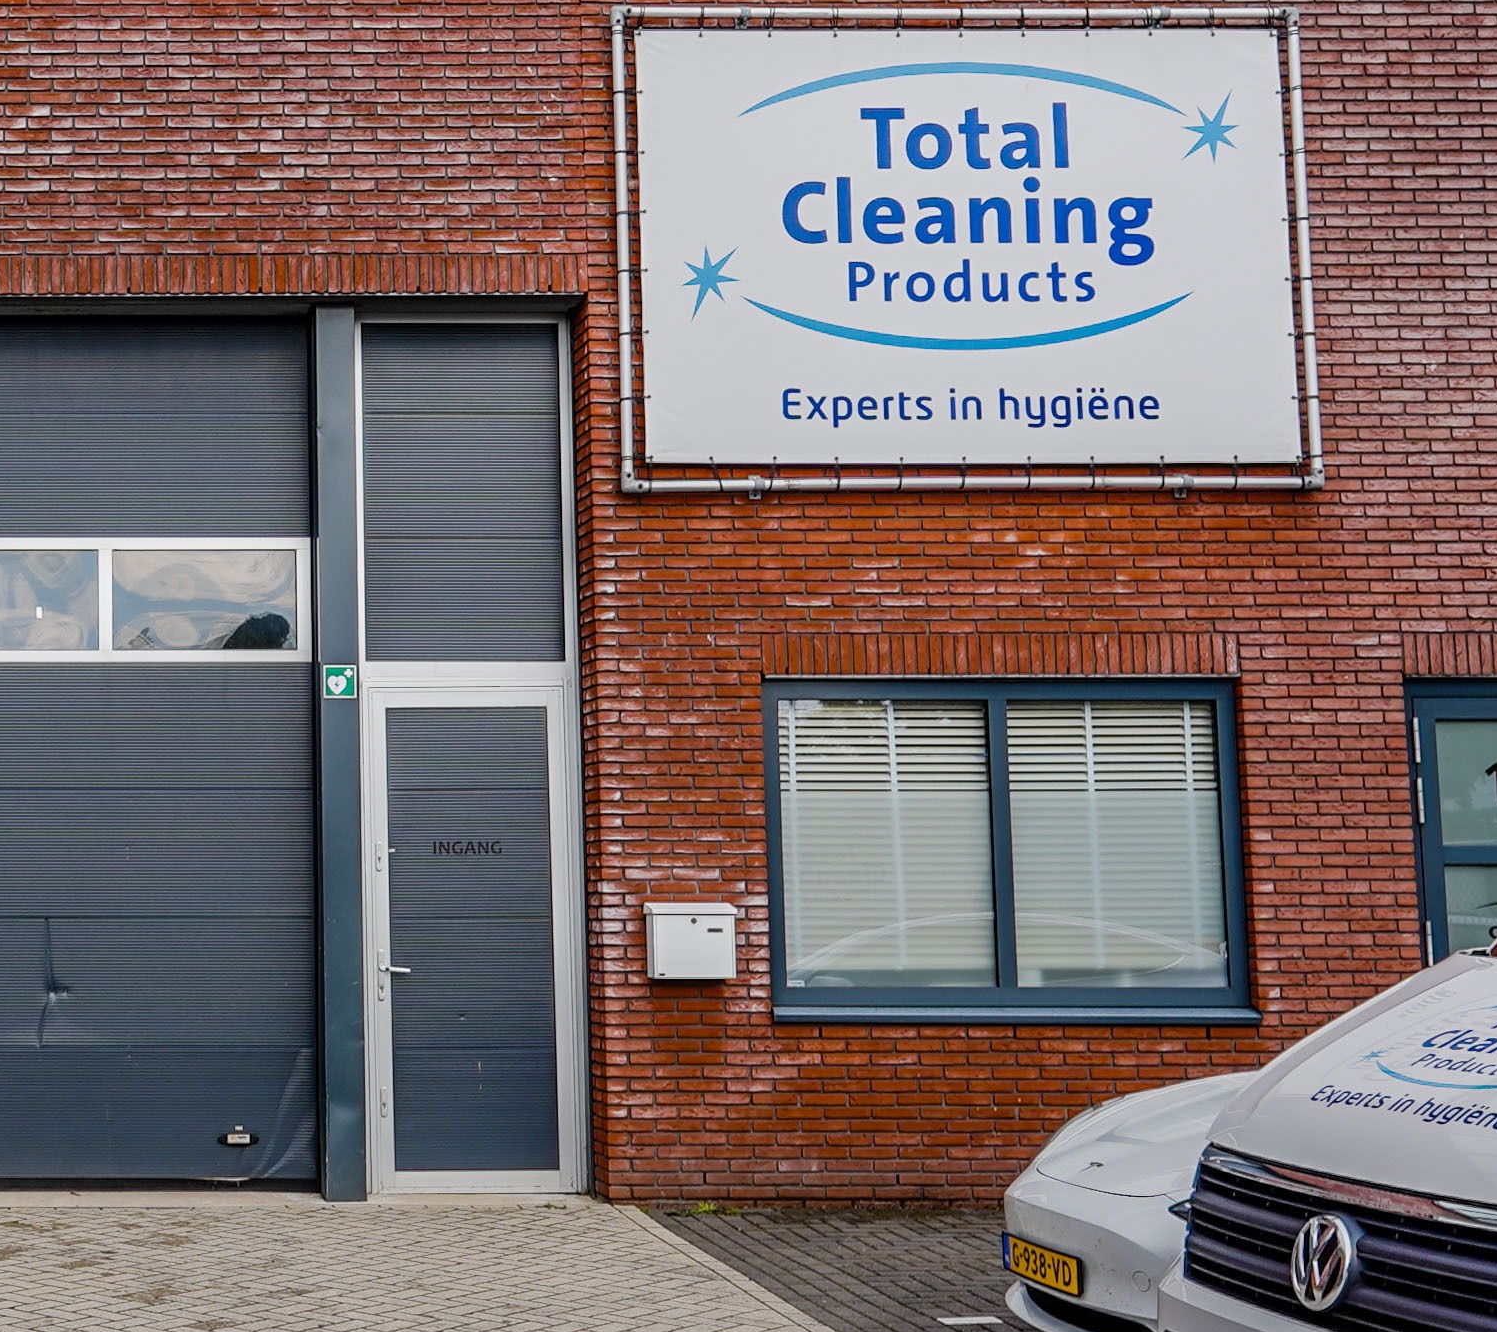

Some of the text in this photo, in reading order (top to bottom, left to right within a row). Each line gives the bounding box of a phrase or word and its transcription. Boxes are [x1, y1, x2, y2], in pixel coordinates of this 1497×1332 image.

[860, 102, 1070, 170] Total
[781, 176, 1156, 267] Cleaning
[847, 259, 1097, 303] Products
[781, 388, 1161, 429] Experts in hygiëne
[432, 840, 503, 856] INGANG
[1310, 1084, 1391, 1109] Experts
[1391, 1093, 1416, 1114] in
[1012, 1242, 1072, 1287] G-938-VD
